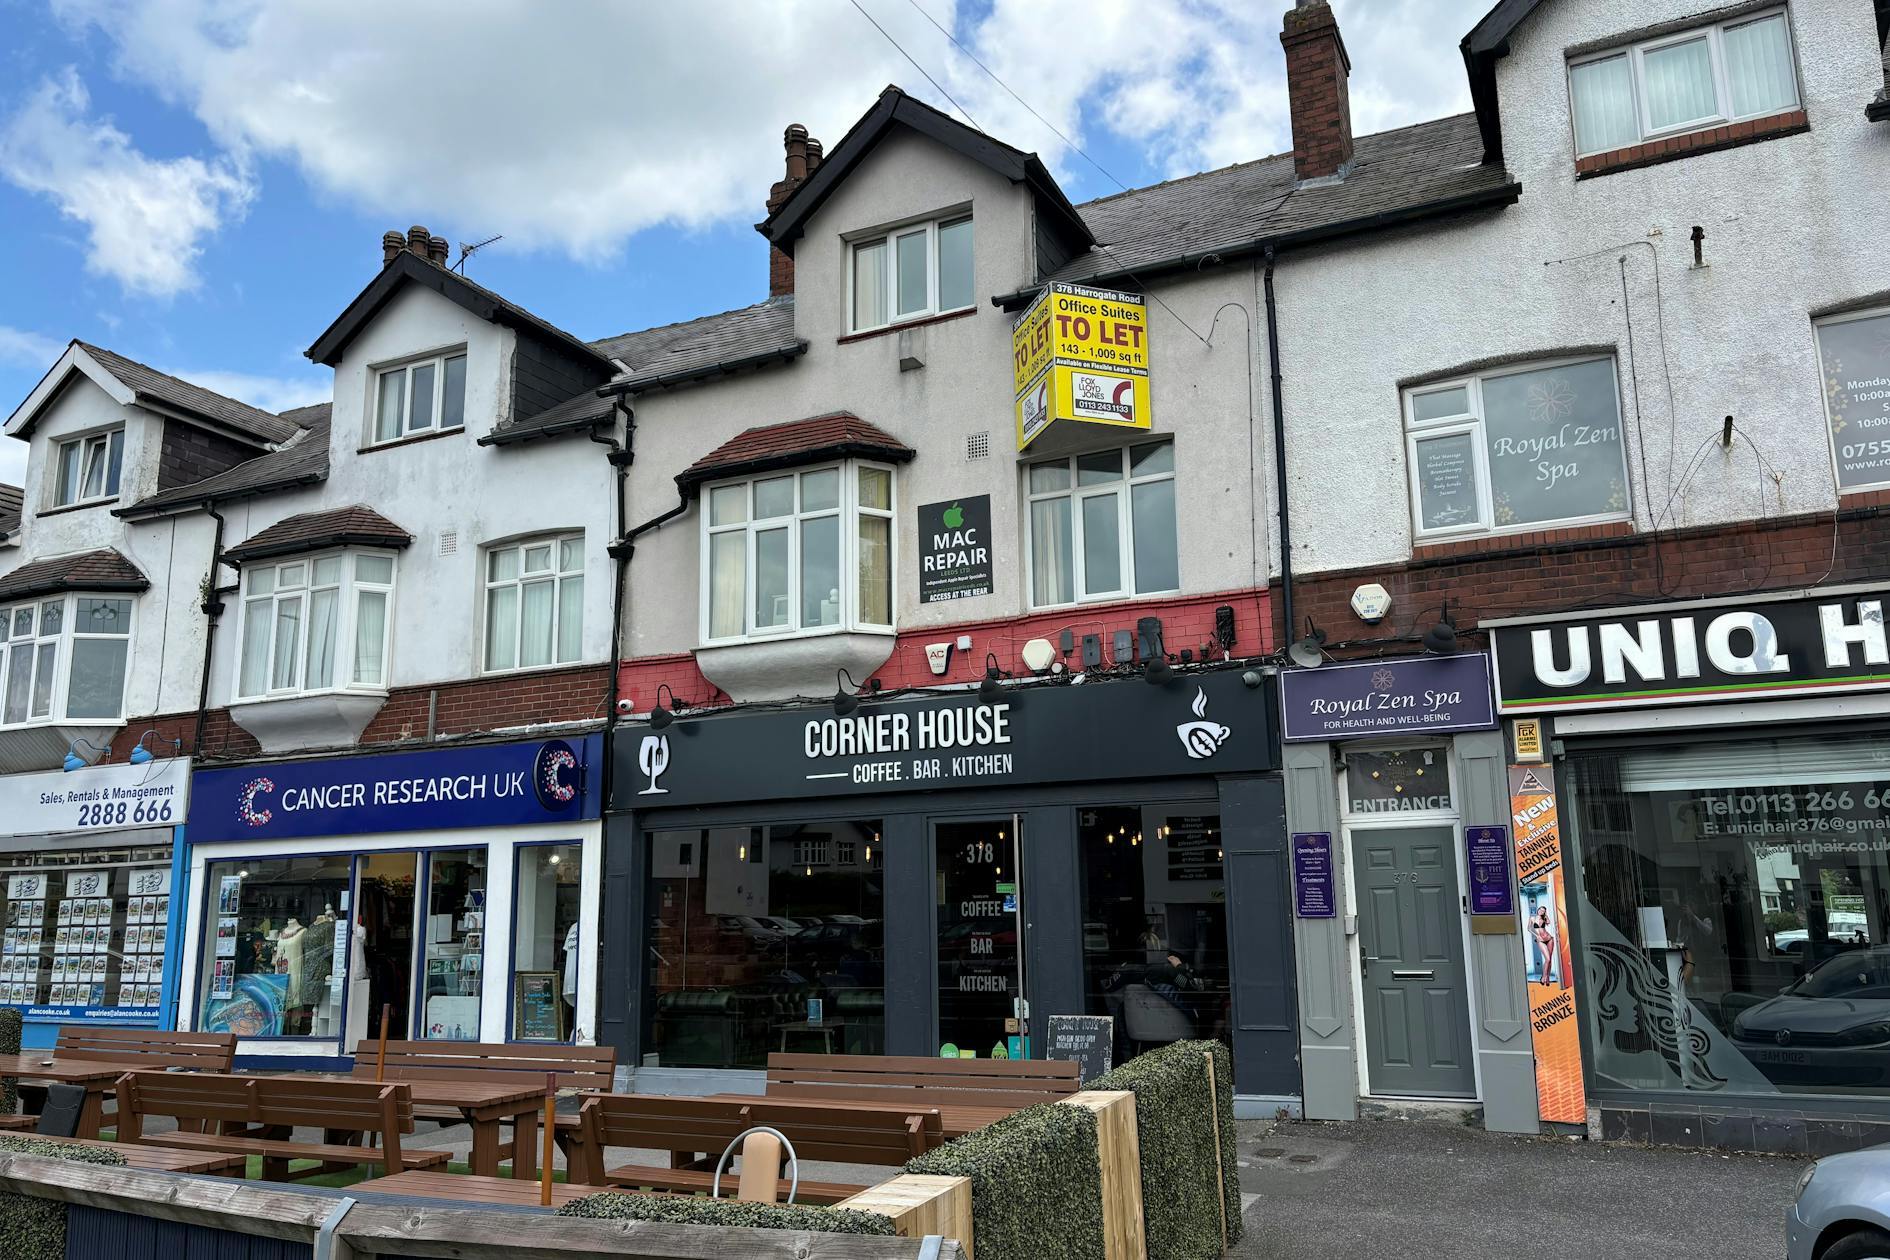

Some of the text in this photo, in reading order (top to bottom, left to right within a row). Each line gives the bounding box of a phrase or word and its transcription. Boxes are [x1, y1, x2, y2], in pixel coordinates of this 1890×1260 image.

[1057, 284, 1072, 294] 378
[1074, 286, 1116, 300] Harrogate
[1059, 298, 1140, 320] Office Suites
[1056, 314, 1144, 348] TO LET
[1015, 343, 1028, 372] TO
[1030, 318, 1050, 357] LET
[1061, 344, 1078, 354] 143
[1089, 347, 1116, 358] 1,009
[1119, 352, 1131, 364] sq
[1134, 352, 1141, 362] ft
[1056, 358, 1082, 366] Available
[1092, 362, 1112, 371] Flexible
[1079, 384, 1100, 392] LLOYD
[1082, 391, 1104, 400] JONES
[1079, 400, 1096, 408] 0113
[1494, 424, 1618, 462] Royal Zen
[1536, 461, 1580, 490] Spa
[934, 528, 976, 550] MAC
[924, 548, 988, 572] REPAIR
[930, 587, 988, 602] ACCESS AT THE REAR
[930, 650, 944, 658] AC
[1530, 600, 1890, 688] UNIQ H
[1310, 690, 1462, 718] Royal Zen Spa
[804, 704, 1011, 758] CORNER HOUSE
[1324, 713, 1451, 729] FOR HEALTH AND WELL-BEING
[853, 762, 902, 784] COFFEE
[914, 759, 940, 780] BAR
[952, 754, 1013, 776] KITCHEN
[40, 784, 174, 804] Sales, Rentals & Management
[282, 784, 366, 812] CANCER
[374, 775, 486, 806] RESEARCH
[494, 772, 526, 798] UK
[1805, 790, 1854, 812] 266
[78, 800, 172, 826] 2888 666
[1352, 796, 1450, 812] ENTRANCE
[1514, 796, 1554, 827] New
[1518, 820, 1556, 847] Exclusive
[1704, 822, 1720, 835] E:
[966, 843, 994, 863] 378
[1518, 832, 1556, 858] TANNING
[1518, 844, 1560, 872] BRONZE
[1394, 872, 1418, 884] 376
[1521, 860, 1558, 884] Stand up beds
[961, 900, 1001, 917] COFFEE
[970, 938, 993, 954] BAR
[960, 976, 1006, 992] KITCHEN
[85, 1008, 160, 1018] enquiries@alancooke.co.uk
[1532, 992, 1571, 1018] TANNING
[1534, 1004, 1575, 1032] BRONZE
